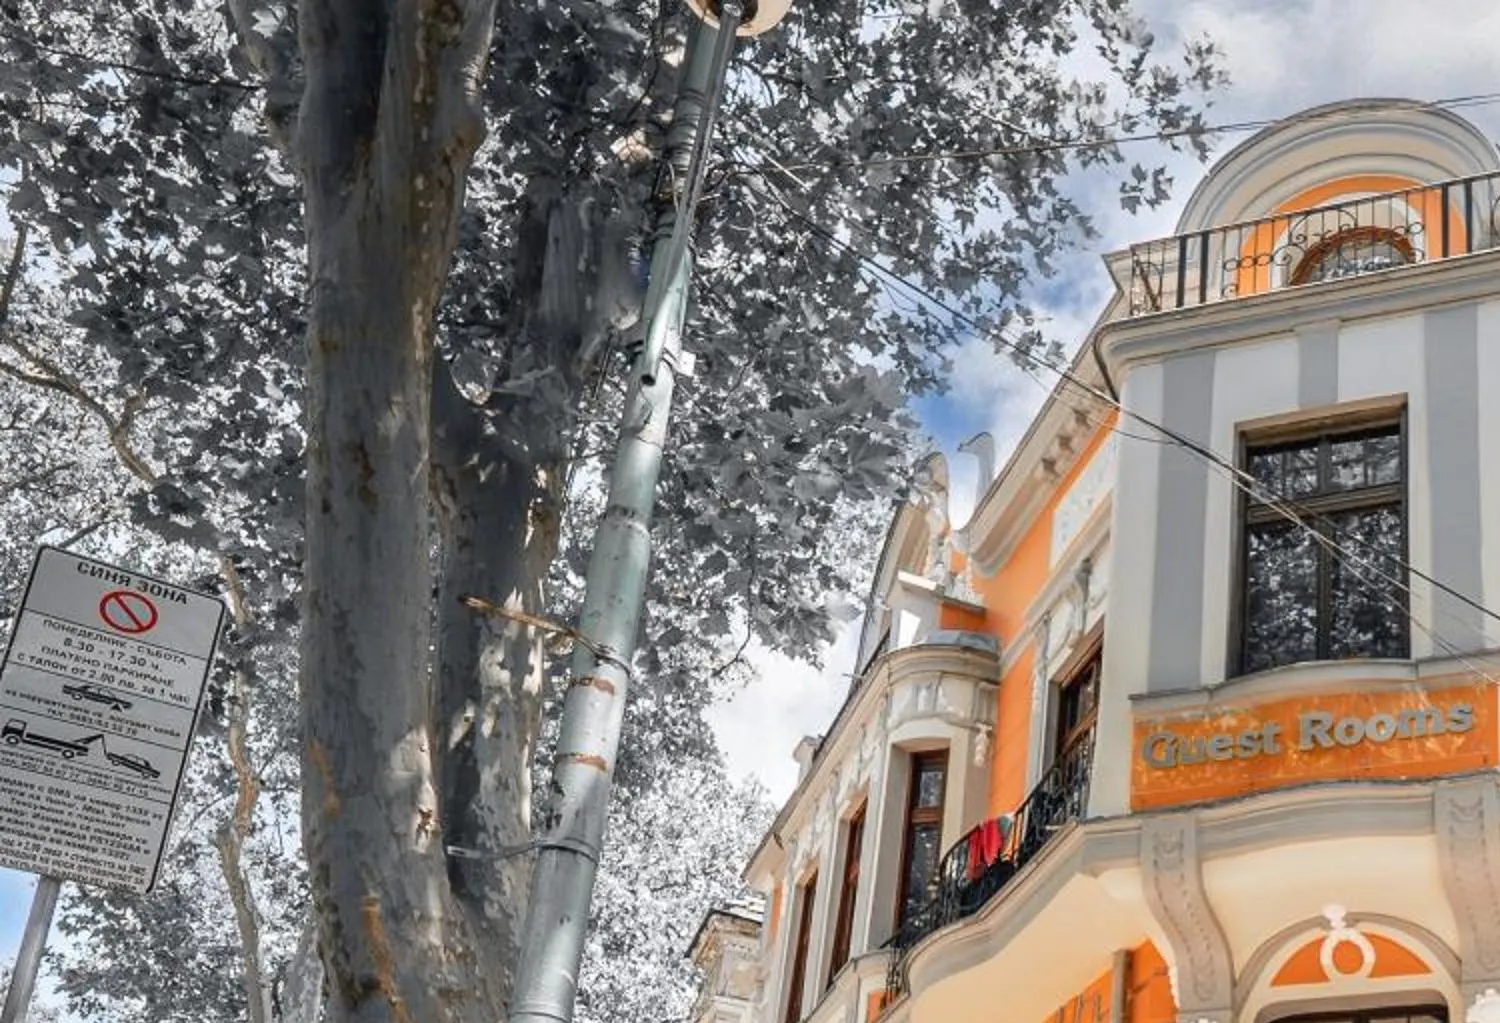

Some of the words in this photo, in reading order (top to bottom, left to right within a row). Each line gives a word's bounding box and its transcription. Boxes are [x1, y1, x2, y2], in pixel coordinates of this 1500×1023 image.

[77, 562, 130, 587] СИНЯ
[137, 581, 188, 604] ЗОНА
[44, 619, 127, 652] ПОНЕДЕЛНИК
[137, 645, 187, 665] СЪБОТА
[1142, 719, 1282, 769] Guest
[1299, 704, 1473, 750] Rooms
